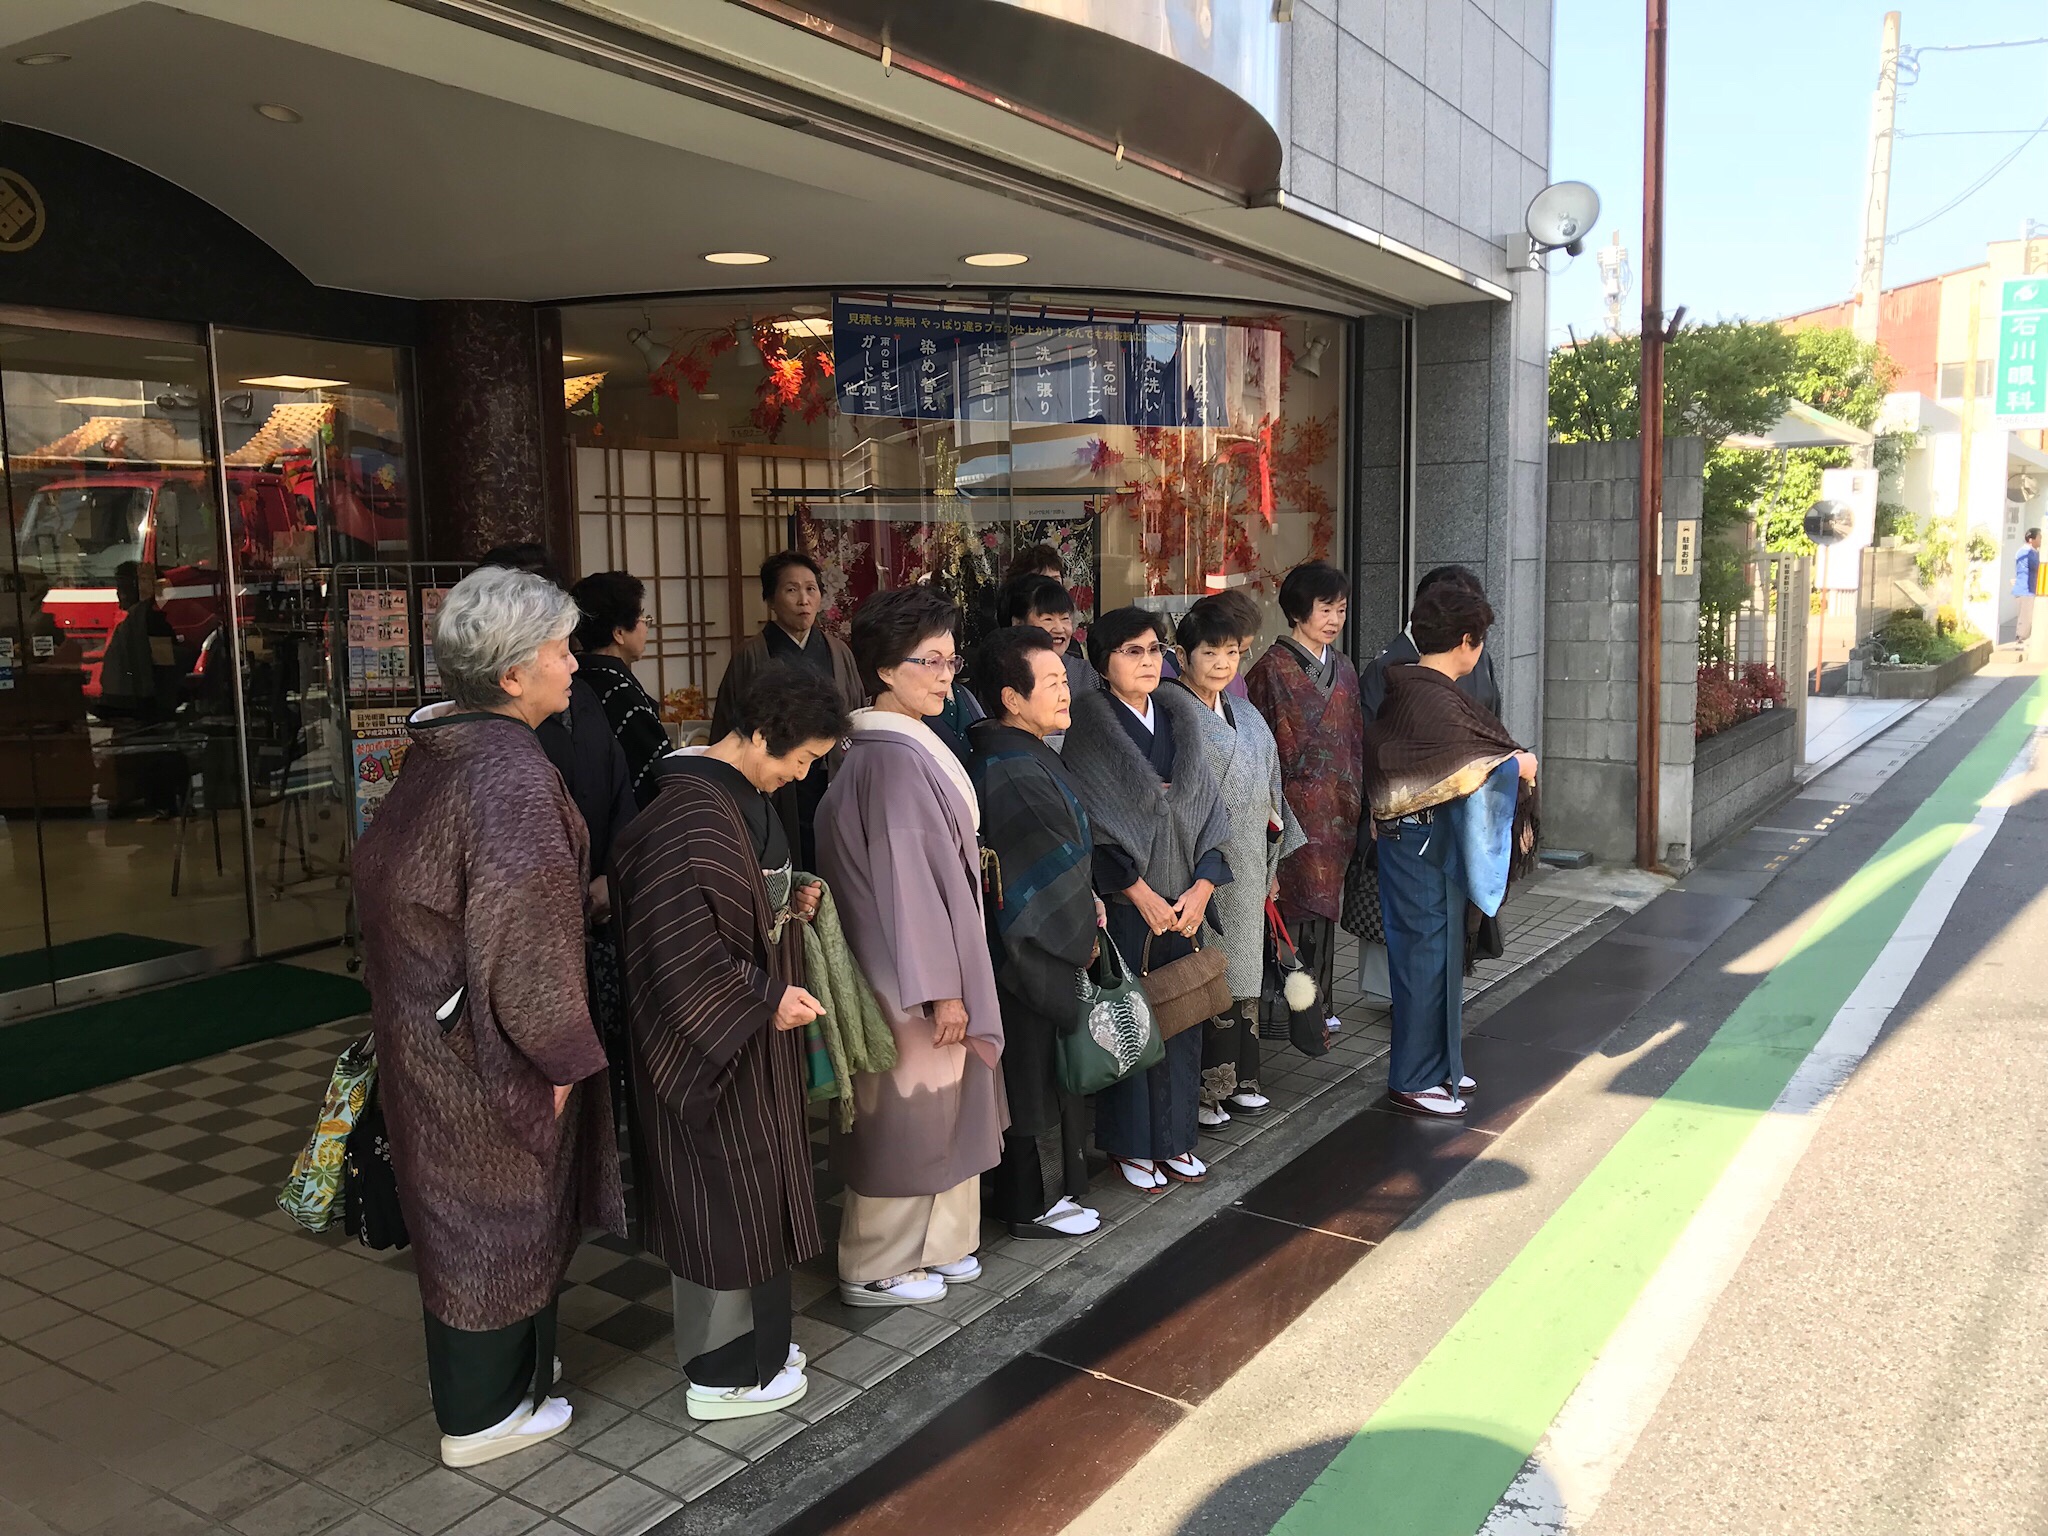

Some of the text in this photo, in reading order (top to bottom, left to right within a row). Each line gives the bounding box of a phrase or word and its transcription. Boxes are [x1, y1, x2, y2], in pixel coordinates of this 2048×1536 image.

[848, 313, 917, 329] 見積もり無料
[861, 334, 880, 411] ガード加工
[879, 336, 893, 402] 雨の日も安心
[919, 338, 938, 411] 染め替え
[978, 342, 996, 413] 仕立直し
[1035, 345, 1054, 415] 洗い張り
[1086, 348, 1102, 418] クリーニング
[1102, 360, 1118, 396] その他
[1143, 358, 1160, 412] 丸洗い
[2005, 316, 2040, 411] 石川眼科
[1681, 536, 1690, 572] 駐車お断り
[357, 713, 386, 721] 日光街道
